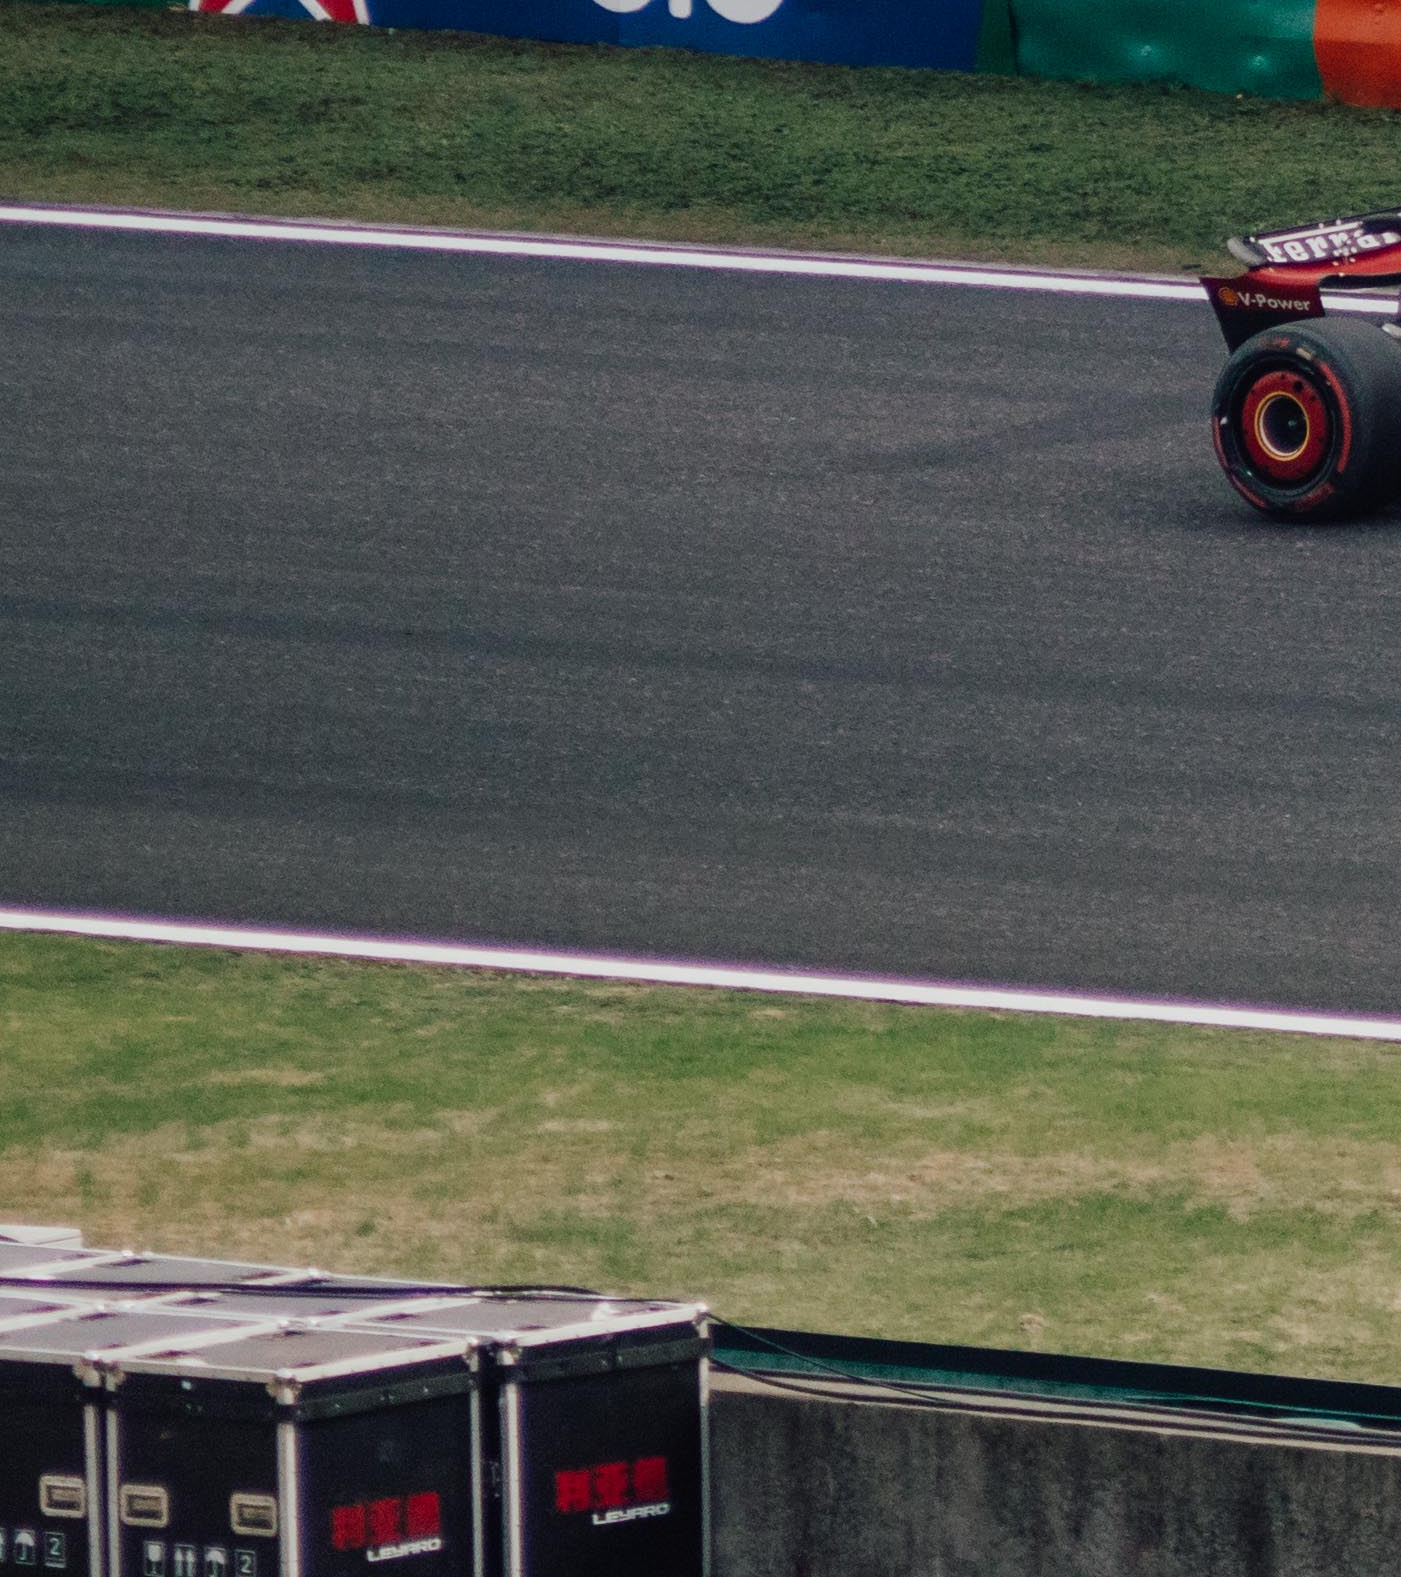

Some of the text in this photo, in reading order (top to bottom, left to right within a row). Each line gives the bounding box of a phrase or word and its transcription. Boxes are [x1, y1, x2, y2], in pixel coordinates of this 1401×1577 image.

[1237, 291, 1311, 311] V-Power
[48, 1537, 60, 1556] 2
[239, 1554, 252, 1574] 2
